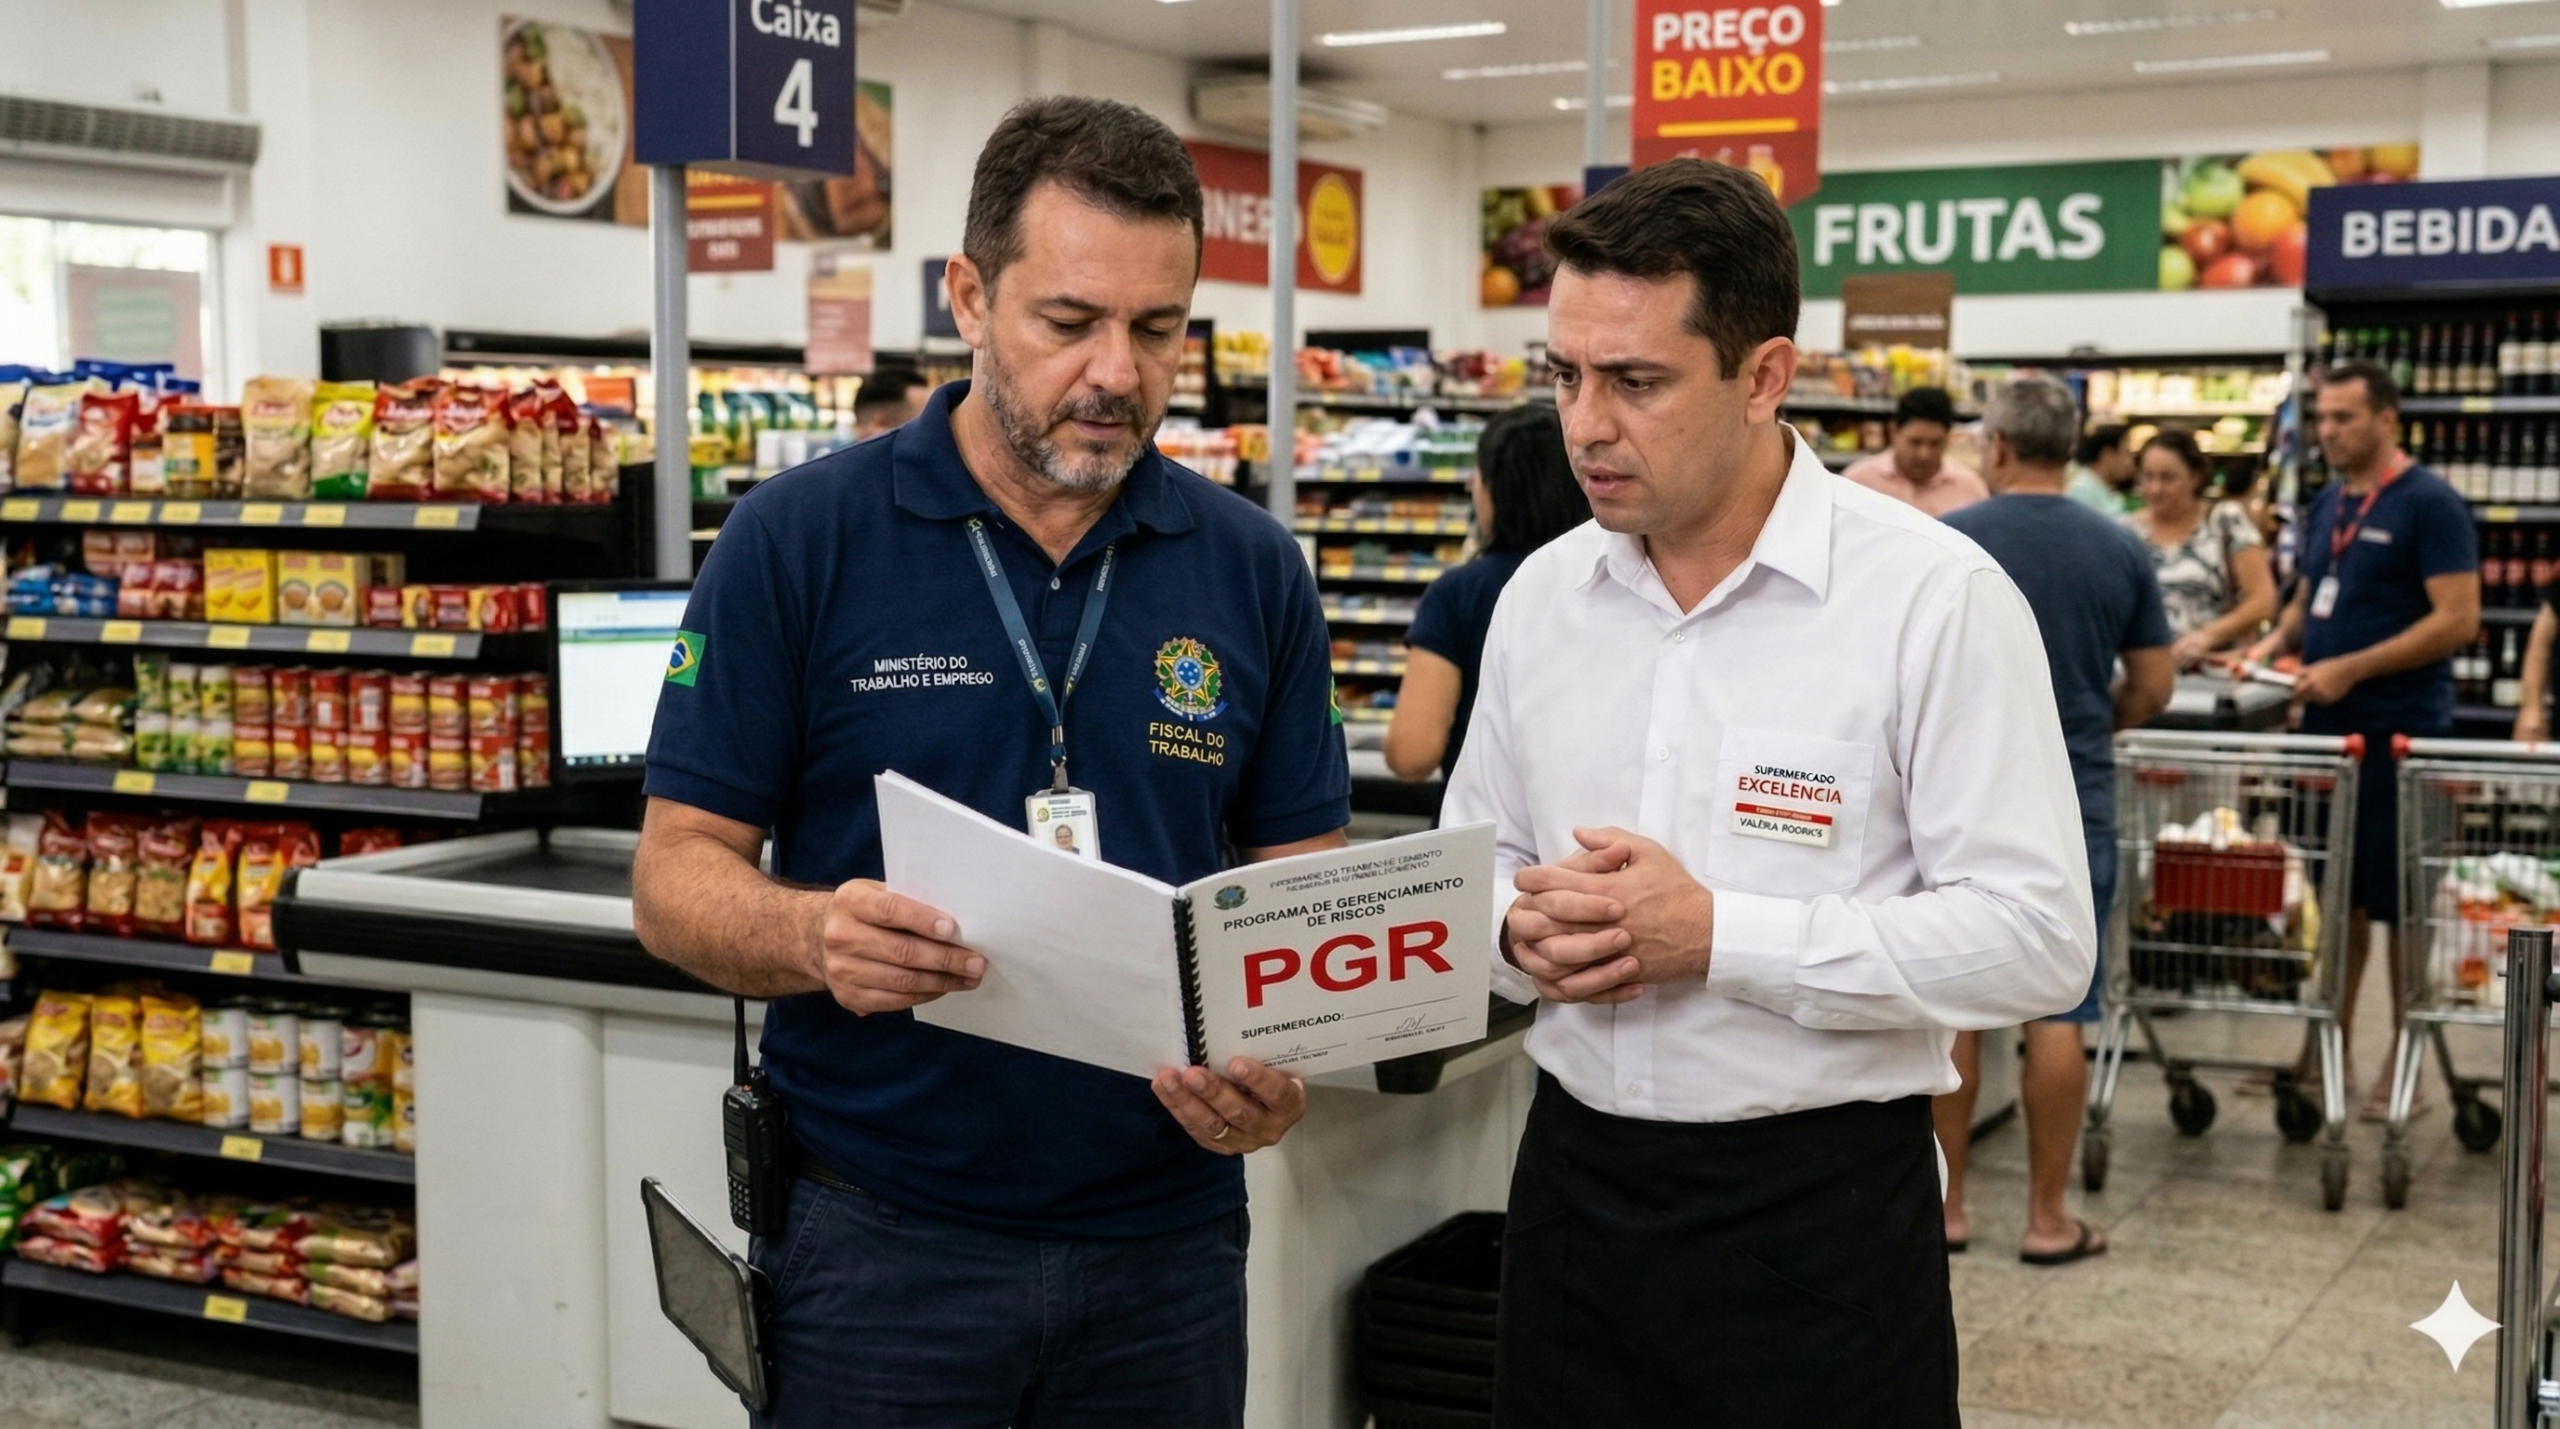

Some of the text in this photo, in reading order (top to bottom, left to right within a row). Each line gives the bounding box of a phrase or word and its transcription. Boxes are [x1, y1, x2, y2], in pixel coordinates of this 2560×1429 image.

[751, 0, 841, 47] Caixa
[1653, 5, 1806, 56] PREÇO
[1652, 52, 1805, 100] BAIXO
[774, 58, 819, 148] 4
[1813, 193, 2106, 266] FRUTAS
[2341, 204, 2560, 258] BEBIDA
[850, 672, 994, 692] TRABALHO E EMPREGO
[874, 653, 968, 673] MINISTÉRIO DO
[1149, 722, 1225, 748] FISCAL DO
[1149, 740, 1224, 766] TRABALHO
[1754, 765, 1836, 784] SUPERMERCADO
[1223, 904, 1309, 932] PROGRAMA
[1312, 900, 1332, 914] DE
[1336, 877, 1464, 909] GERENCIAMENTO
[1307, 903, 1386, 928] DE RISCOS
[1243, 920, 1455, 1010] PGR
[1241, 1012, 1345, 1040] SUPERMERCADO:
